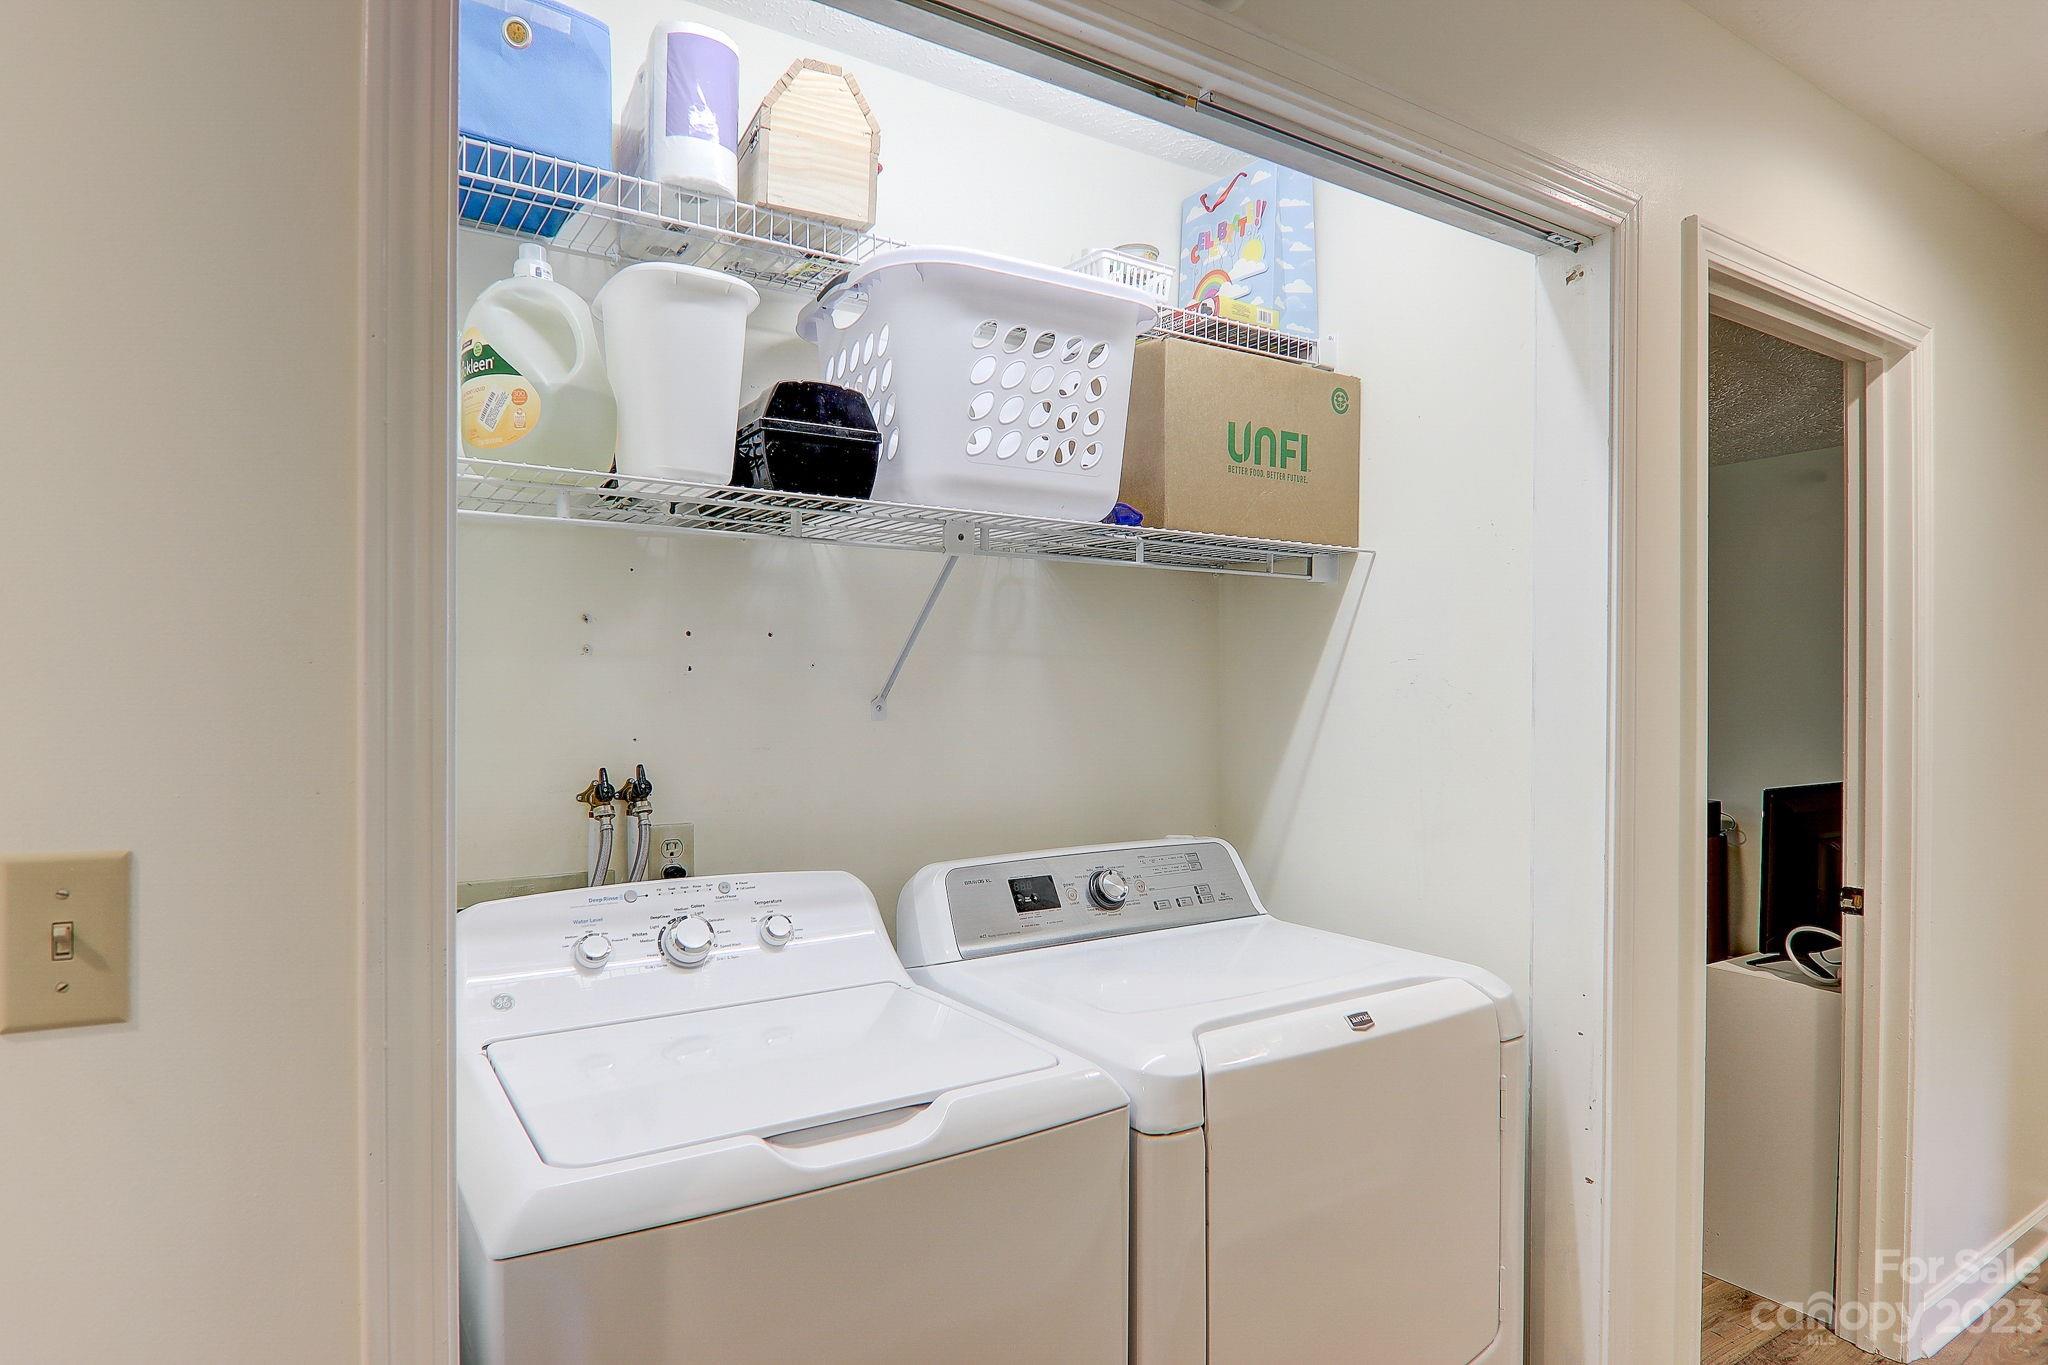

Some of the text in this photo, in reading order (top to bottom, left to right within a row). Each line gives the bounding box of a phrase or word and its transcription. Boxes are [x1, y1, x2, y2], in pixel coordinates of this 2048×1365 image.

[1228, 464, 1309, 484] BETTER FOOD. BETTER FUTURE.
